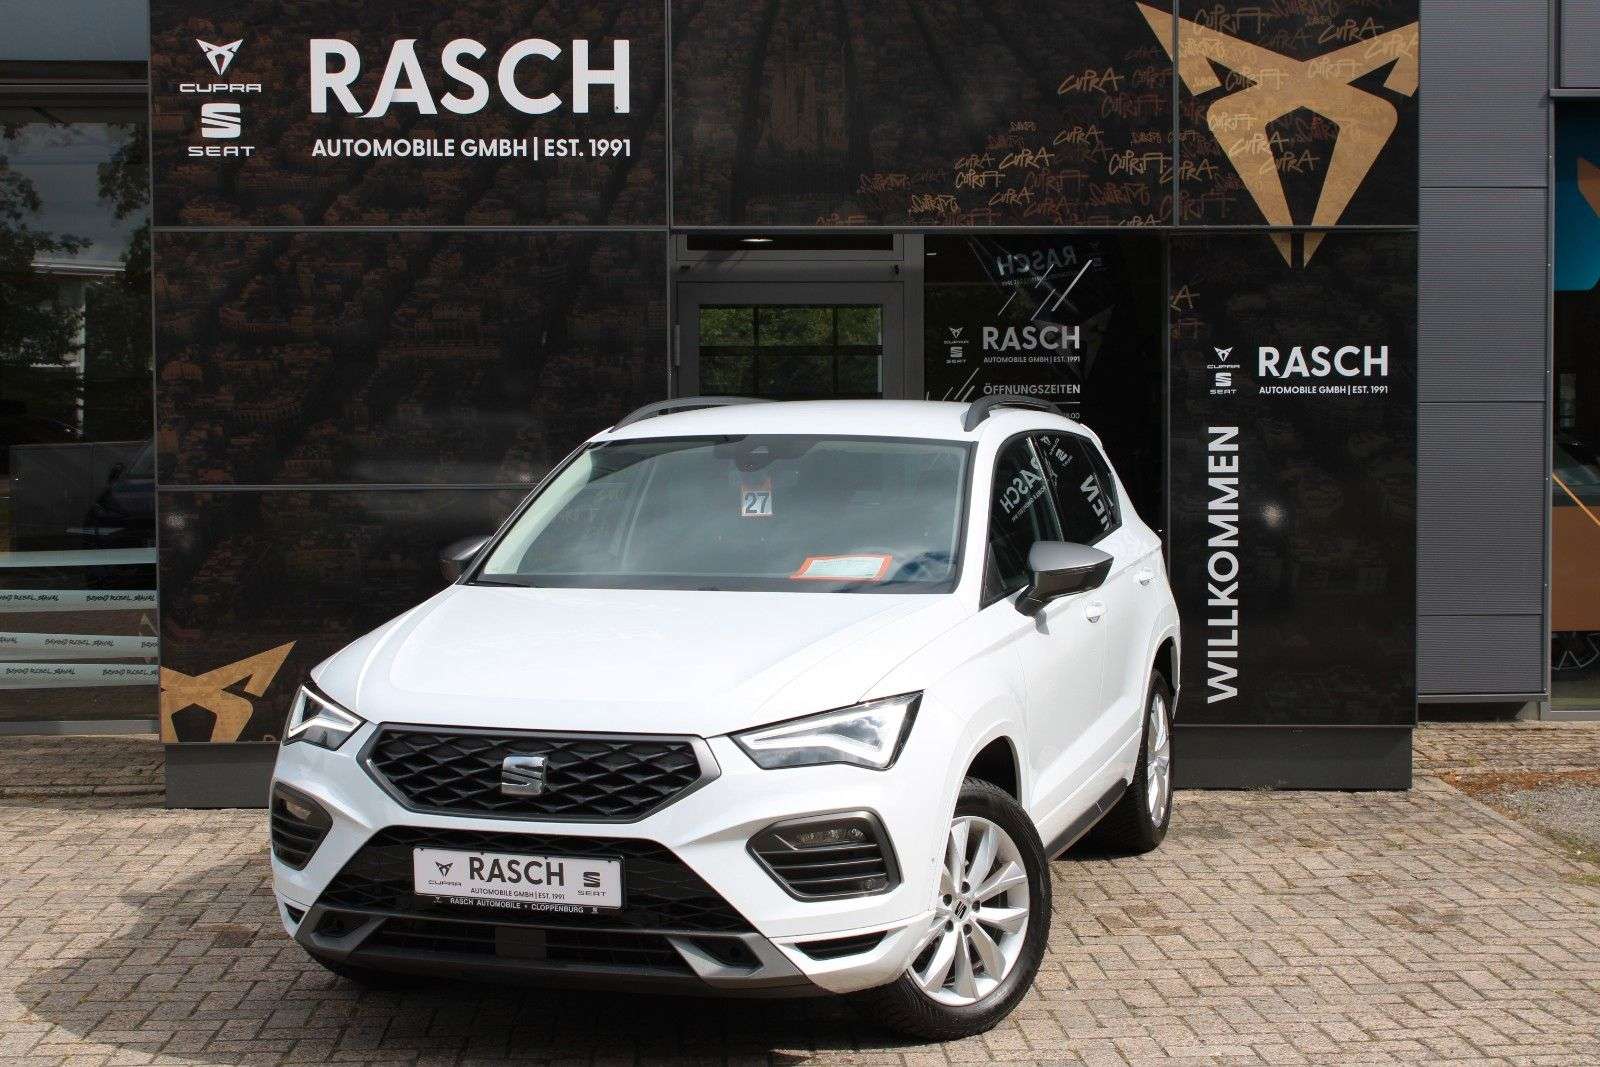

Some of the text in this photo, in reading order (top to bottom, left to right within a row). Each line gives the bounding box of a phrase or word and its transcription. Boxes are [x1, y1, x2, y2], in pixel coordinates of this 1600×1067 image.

[310, 38, 629, 118] RASCH
[1057, 67, 1124, 95] CUPRA
[179, 83, 262, 93] CUPRA
[187, 146, 255, 157] SEAT
[311, 138, 631, 157] AUTOMOBILE GMBH EST. 1991
[983, 326, 1080, 351] RASCH
[1258, 345, 1389, 379] RASCH
[983, 382, 1081, 395] ÖFFNUNGSZEITEN
[1258, 385, 1389, 394] AUTOMOBILE GMBH EST. 1991
[745, 493, 768, 514] 27
[1207, 426, 1239, 704] WILLKOMMEN
[469, 856, 565, 887] RASCH
[470, 887, 512, 897] AUTOMOBILE
[513, 890, 534, 898] GMBH
[538, 892, 551, 900] EST.
[576, 889, 606, 897] SEAT
[450, 897, 584, 914] RASCH AUTOMOBILE CLOPPENBURG
